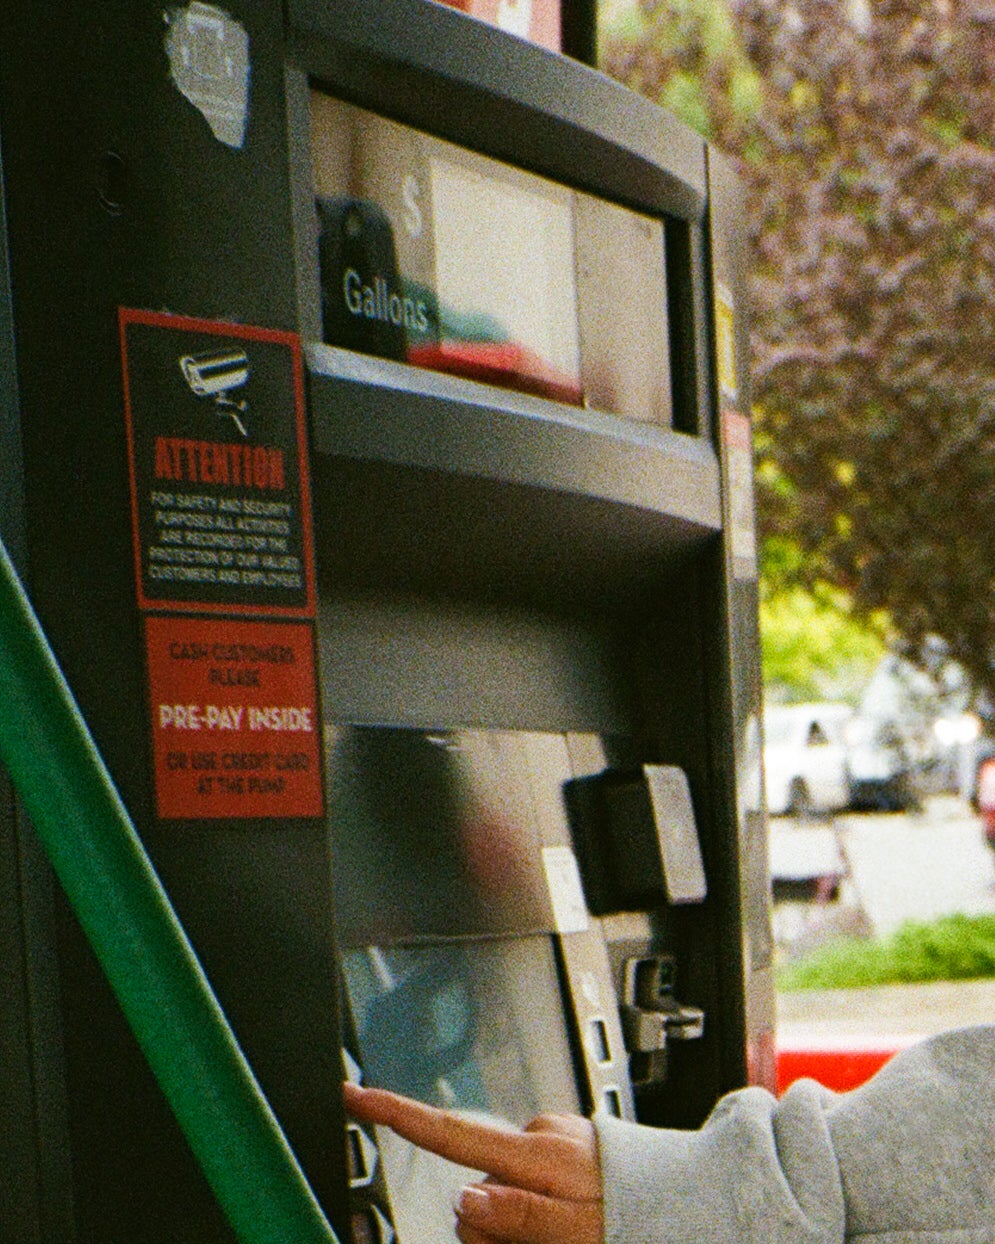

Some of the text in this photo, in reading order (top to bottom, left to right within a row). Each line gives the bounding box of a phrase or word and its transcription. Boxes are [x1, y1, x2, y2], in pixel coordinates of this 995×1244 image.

[344, 269, 428, 332] Gallons
[156, 437, 284, 490] ATTENTION
[159, 704, 313, 732] PRE-PAY INSIDE
